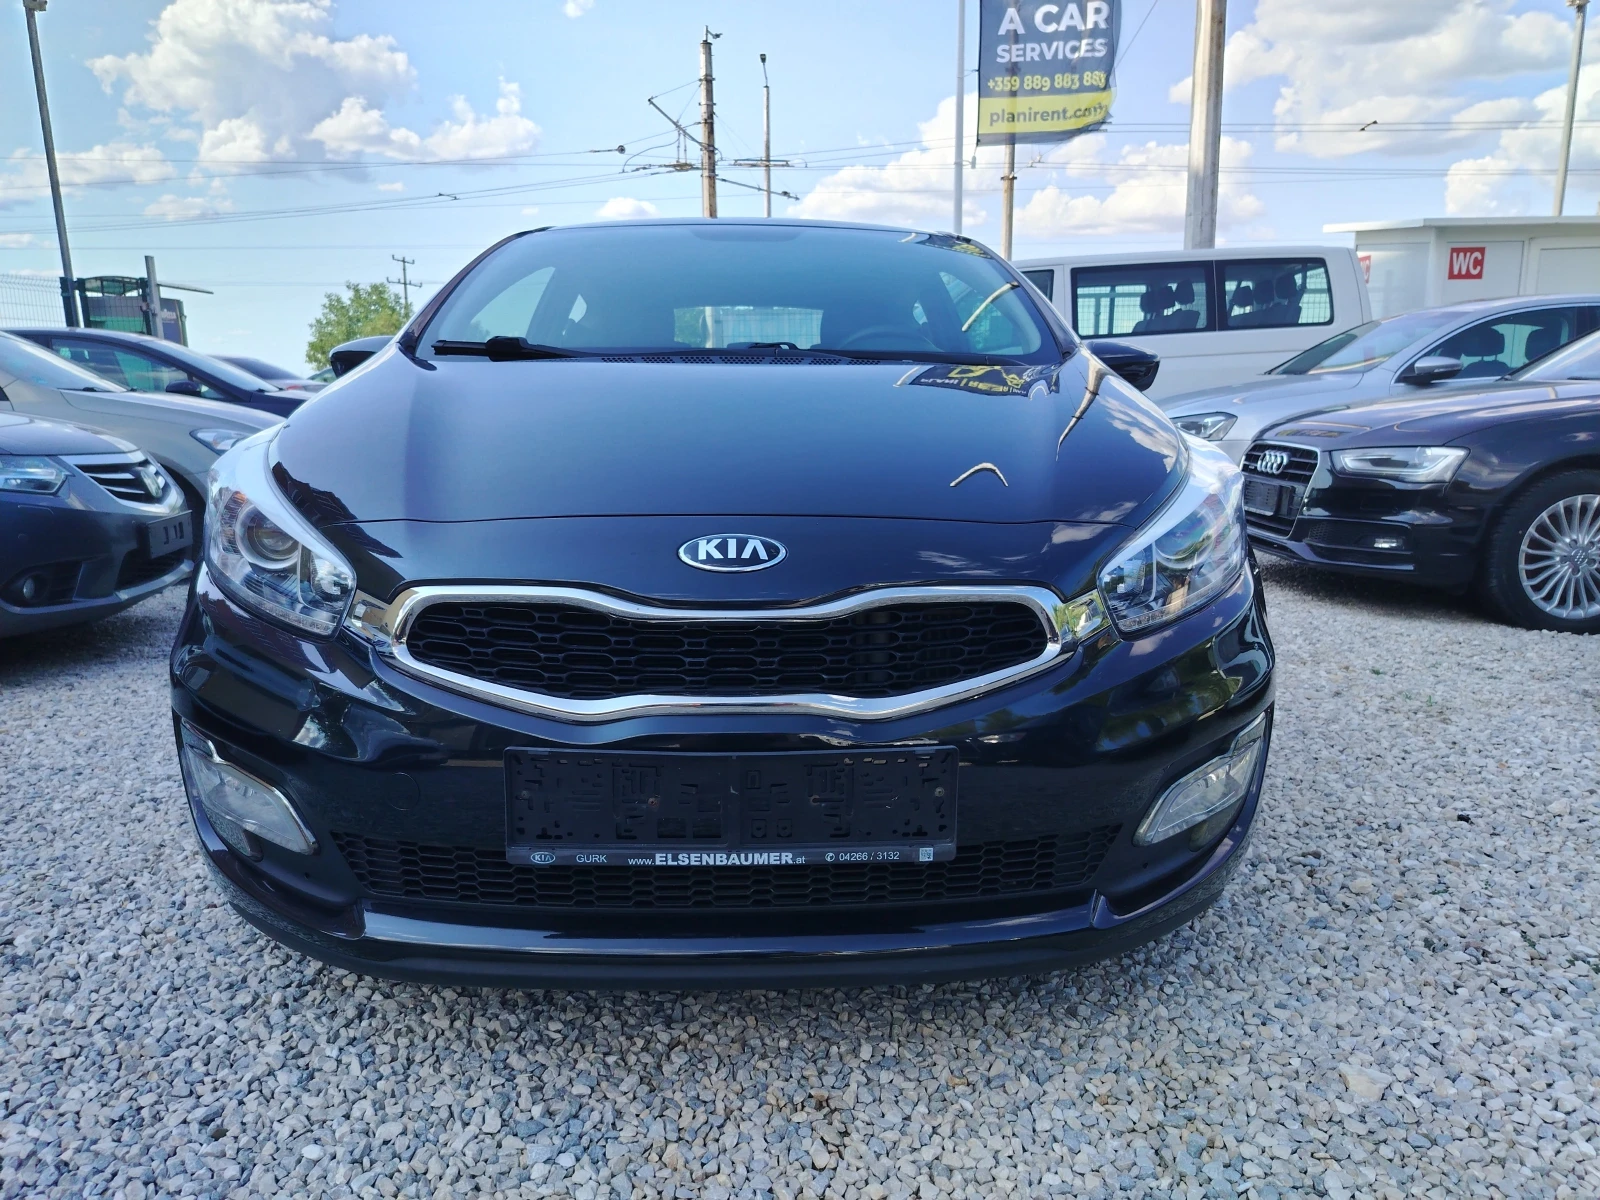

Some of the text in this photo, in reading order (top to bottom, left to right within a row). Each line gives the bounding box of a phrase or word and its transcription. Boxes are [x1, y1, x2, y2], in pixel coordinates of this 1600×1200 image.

[998, 1, 1110, 35] A CAR
[996, 38, 1108, 63] SERVICES
[987, 76, 1020, 91] +359
[1023, 75, 1050, 91] 889
[1054, 73, 1080, 89] 883
[1452, 251, 1482, 276] WC
[697, 538, 769, 561] KIA
[576, 854, 607, 863] GURK
[627, 852, 806, 866] www.ELSENBAUMER.at
[838, 852, 868, 861] 04266
[876, 851, 900, 860] 3132
